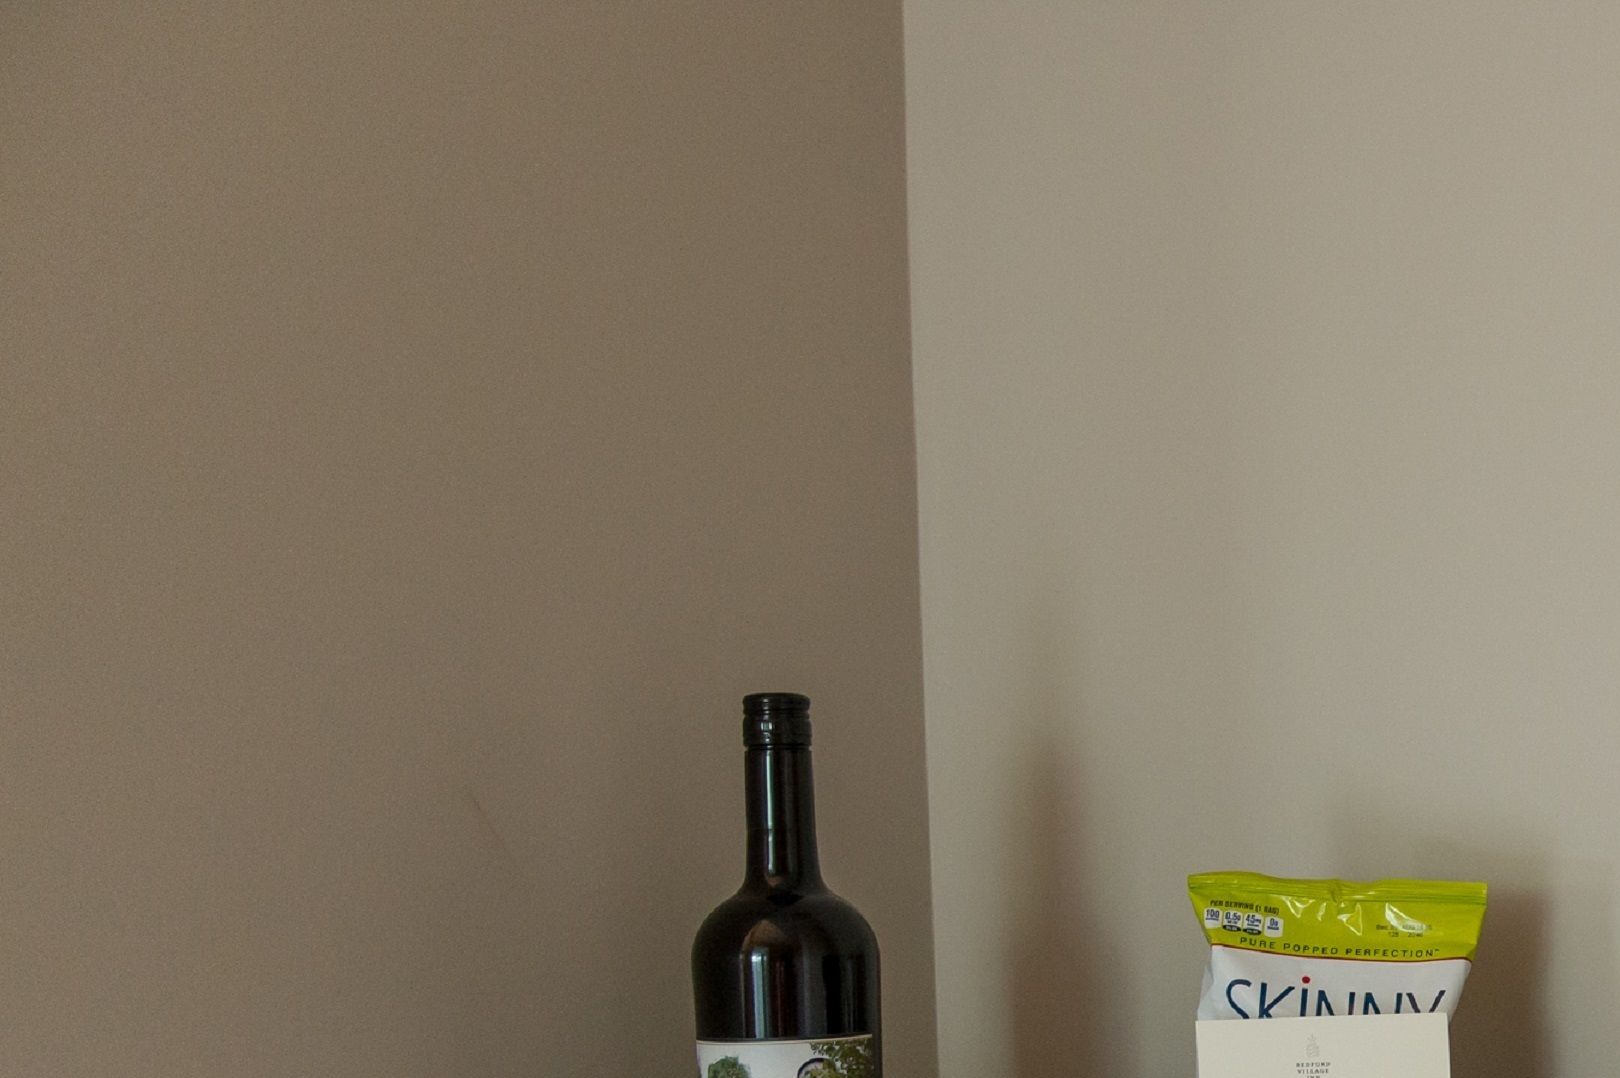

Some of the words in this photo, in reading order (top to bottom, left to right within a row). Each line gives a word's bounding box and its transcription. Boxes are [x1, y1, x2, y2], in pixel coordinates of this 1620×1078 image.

[1206, 909, 1220, 919] 100
[1240, 936, 1276, 950] PURE
[1283, 943, 1338, 955] POPPED
